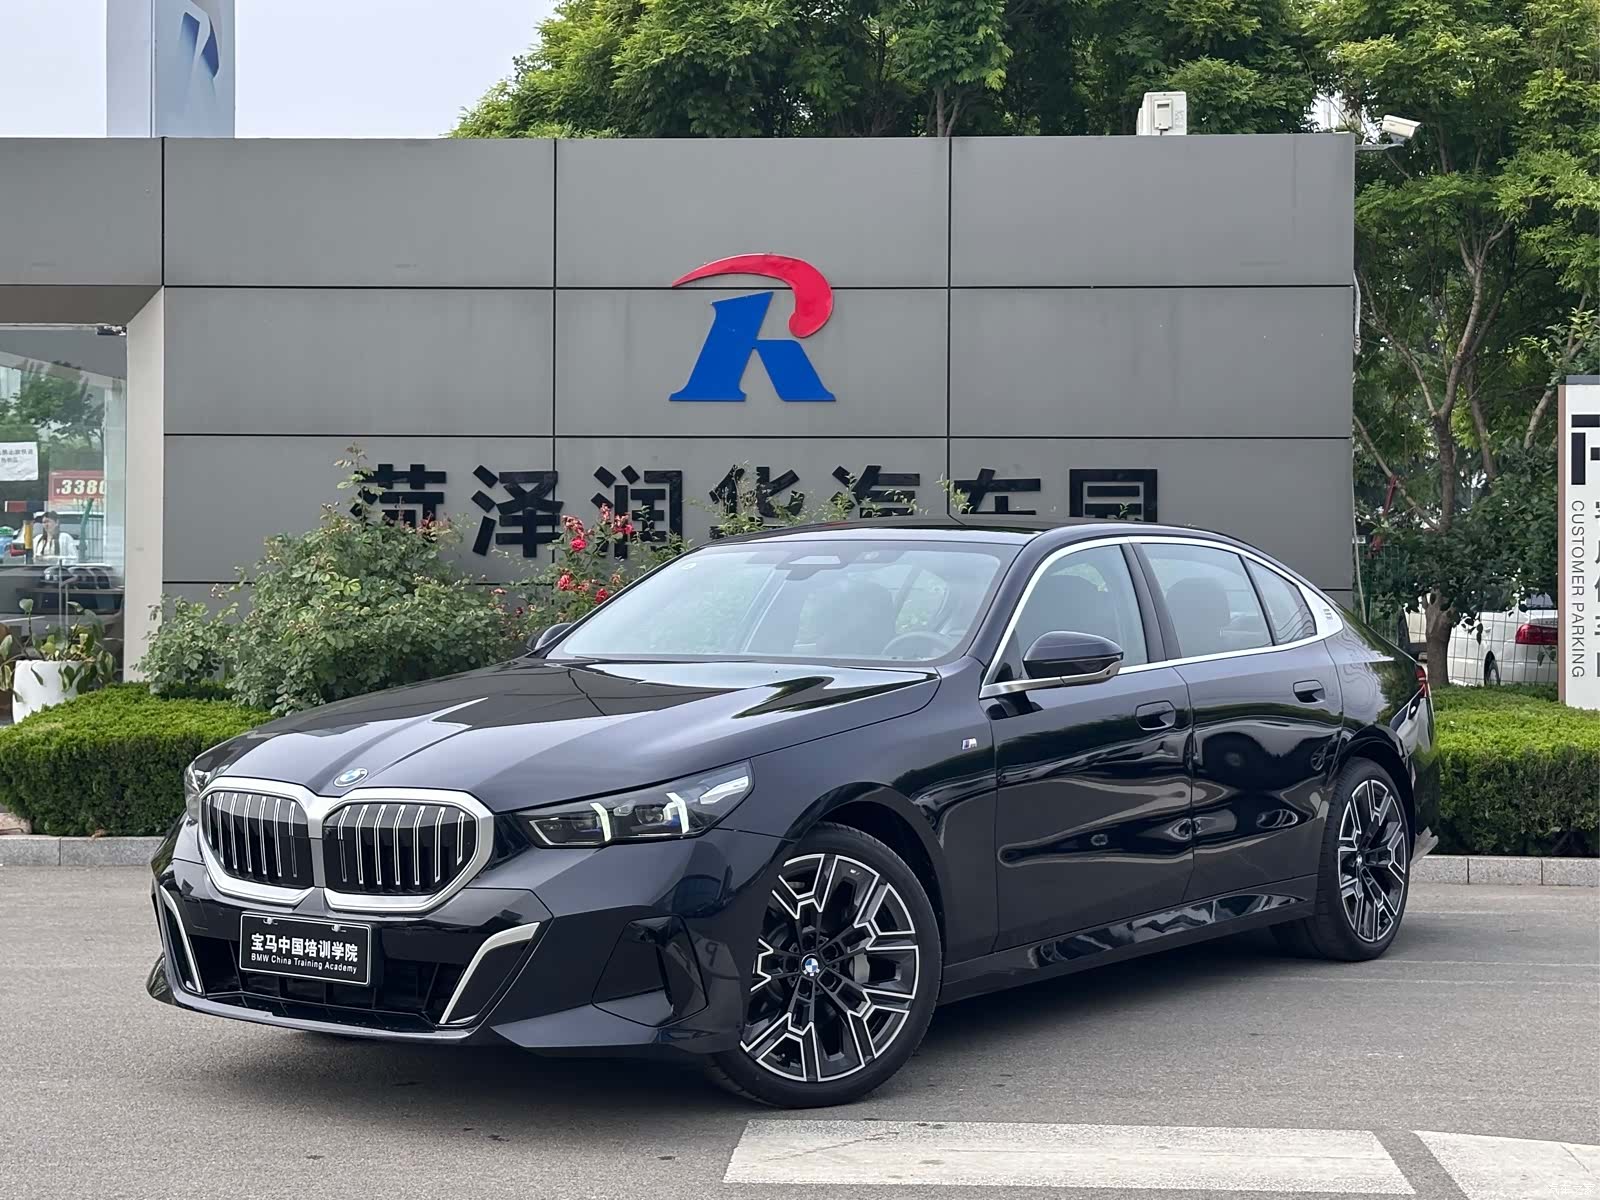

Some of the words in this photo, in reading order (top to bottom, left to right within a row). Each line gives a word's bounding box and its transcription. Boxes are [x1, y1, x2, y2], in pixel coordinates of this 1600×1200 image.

[1571, 500, 1585, 596] CUSTOMER
[1571, 602, 1585, 678] PARKING
[251, 932, 358, 962] 宝马中国培训学院
[251, 952, 269, 962] BMW
[271, 954, 292, 965] China
[293, 957, 323, 970] Training
[324, 961, 357, 975] Academy
